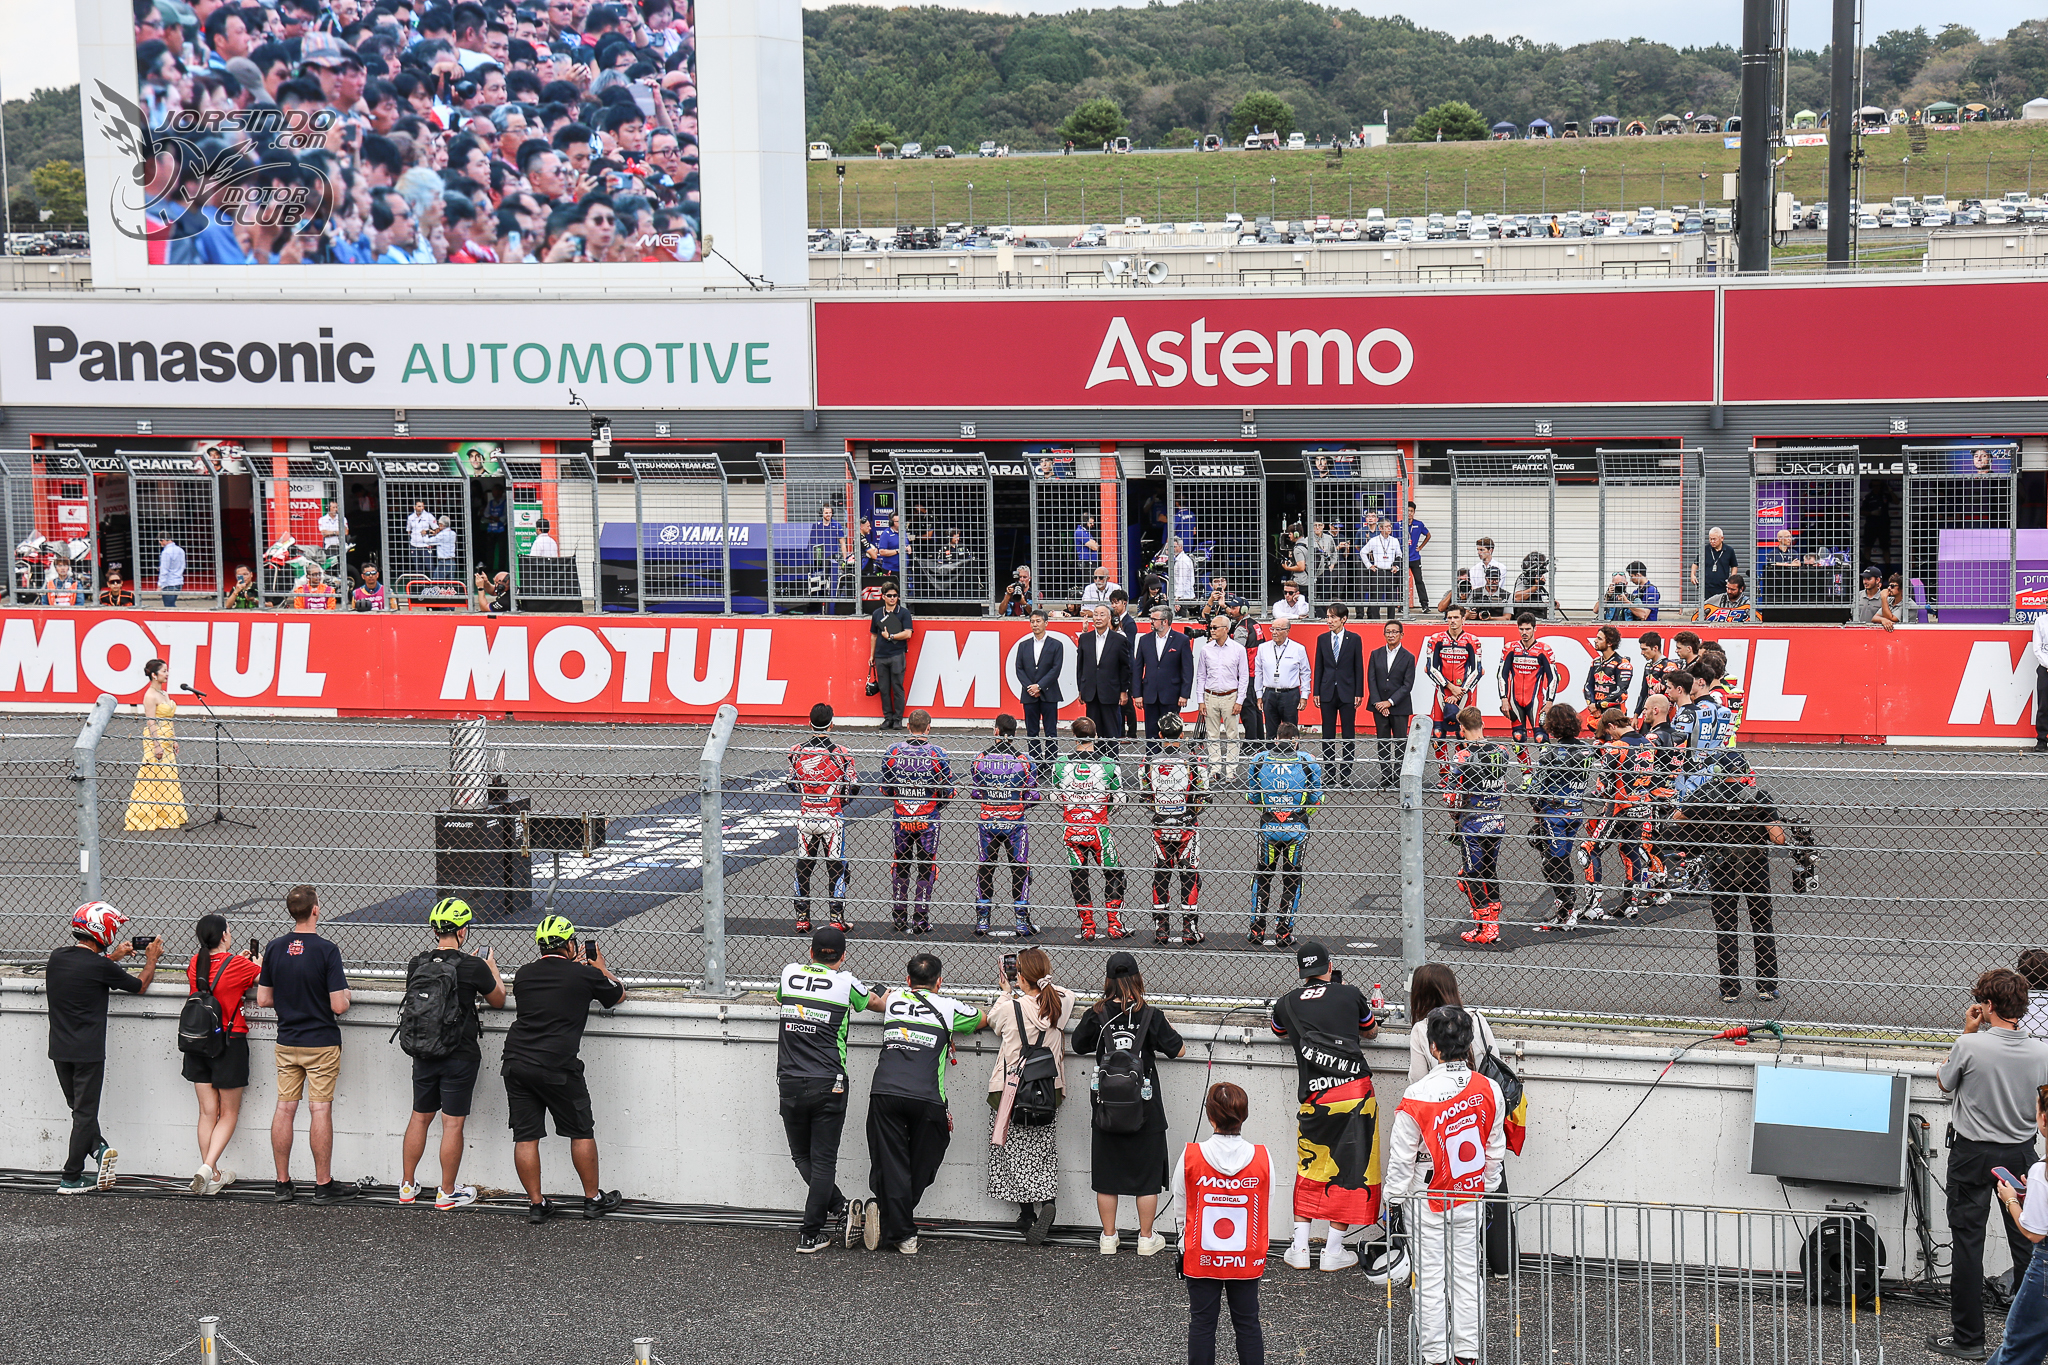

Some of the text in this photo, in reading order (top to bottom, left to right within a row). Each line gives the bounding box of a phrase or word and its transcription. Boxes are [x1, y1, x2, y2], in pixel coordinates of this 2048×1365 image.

[33, 325, 771, 384] Panasonic AUTOMOTIVE
[1084, 316, 1414, 389] Astemo
[139, 421, 148, 431] 7
[397, 424, 406, 433] 8
[659, 424, 667, 435] 9
[962, 426, 975, 436] 10
[1243, 426, 1255, 436] 11
[1537, 423, 1550, 433] 12
[1892, 420, 1906, 431] 13
[385, 462, 440, 472] ZARCO
[1199, 465, 1245, 476] RINS
[1512, 463, 1575, 471] FANTIC RCING
[1780, 462, 1834, 475] JACK
[682, 526, 749, 542] YAMAHA
[0, 618, 327, 697] MOTUL
[439, 624, 788, 705] MOTUL
[899, 821, 929, 833] MILLER
[788, 974, 833, 992] CIP
[1300, 986, 1327, 1000] 89
[805, 1009, 828, 1019] Power
[889, 1000, 933, 1017] CIP
[791, 1023, 816, 1033] IPONE
[910, 1031, 934, 1042] Power
[1432, 1093, 1484, 1131] MotoGP
[1448, 1117, 1474, 1132] MEDICAL
[1195, 1175, 1260, 1190] MotoGP
[1212, 1255, 1246, 1267] JPN
